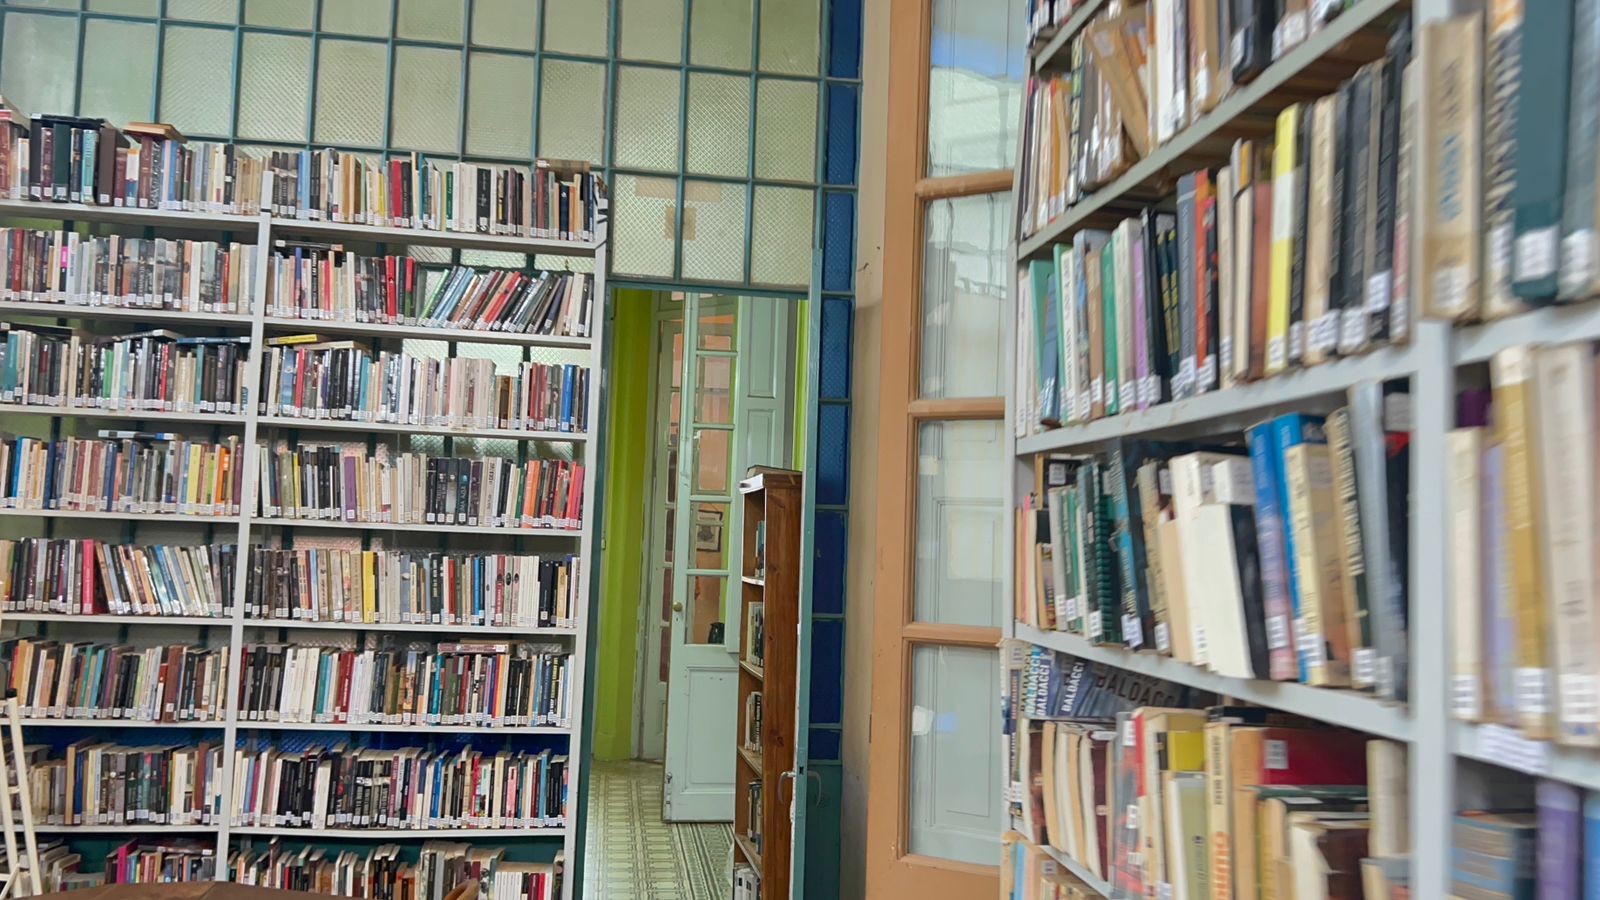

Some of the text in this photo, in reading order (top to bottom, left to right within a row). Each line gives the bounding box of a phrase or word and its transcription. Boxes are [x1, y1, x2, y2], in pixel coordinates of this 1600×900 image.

[1025, 654, 1040, 714] BALDACCI
[1036, 664, 1050, 716] BALDACCI
[1060, 661, 1086, 712] BALDACCI
